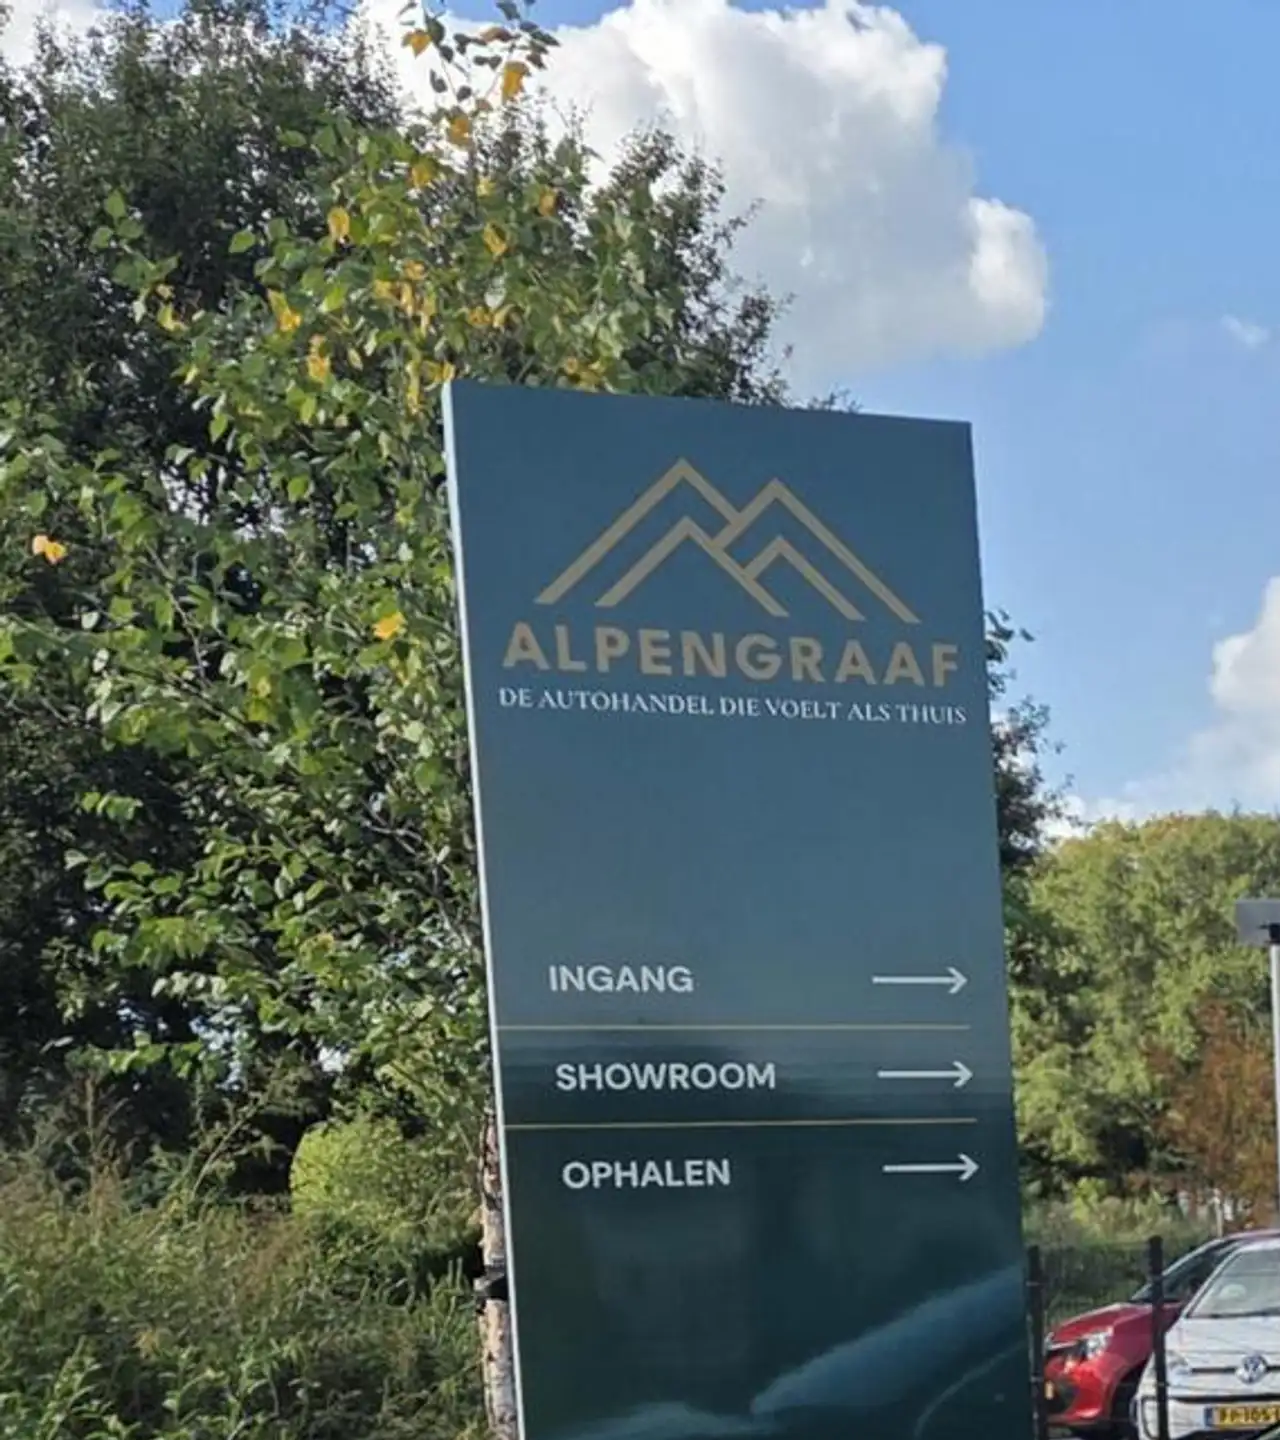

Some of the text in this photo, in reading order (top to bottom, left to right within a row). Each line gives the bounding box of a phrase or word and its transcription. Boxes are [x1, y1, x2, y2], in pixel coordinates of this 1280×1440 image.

[503, 621, 959, 688] ALPENGRAAF
[498, 686, 968, 726] DE AUTOHANDEL DIE VOELT ALS THUIS
[549, 965, 694, 993] INGANG
[555, 1062, 776, 1092] SHOWROOM
[562, 1158, 731, 1190] OPHALEN
